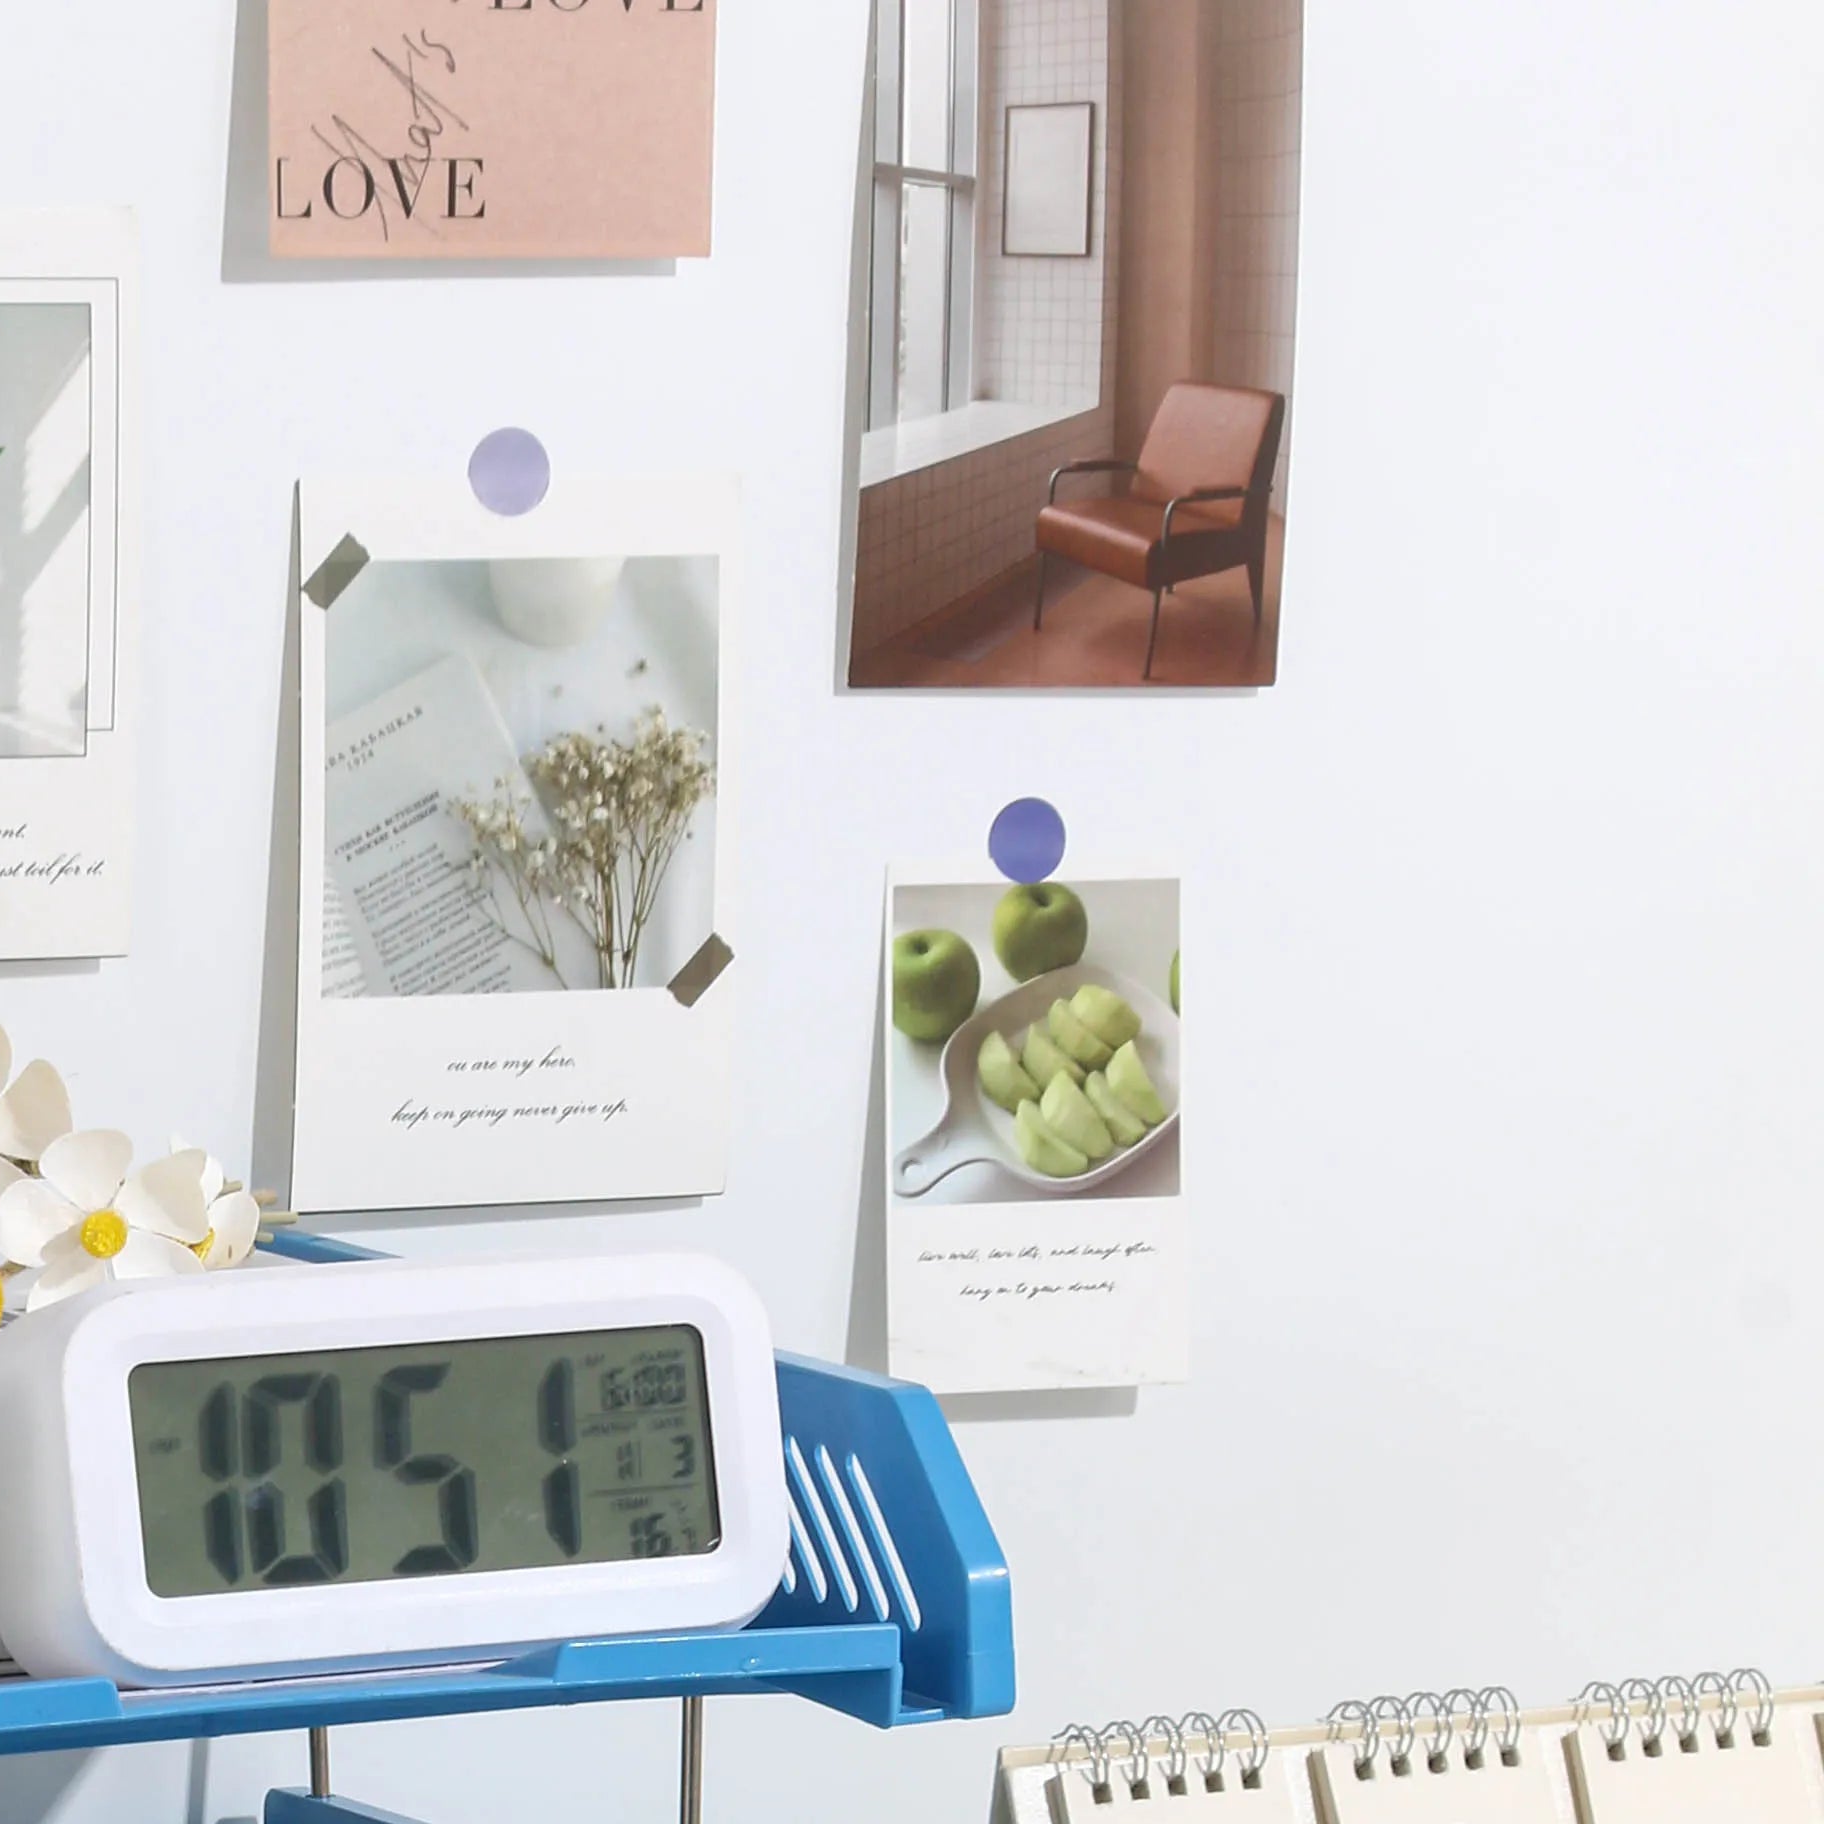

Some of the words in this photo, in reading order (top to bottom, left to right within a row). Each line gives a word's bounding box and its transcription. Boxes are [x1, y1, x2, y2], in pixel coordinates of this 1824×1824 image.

[277, 157, 485, 219] LOVE
[24, 857, 54, 878] toil
[50, 853, 81, 886] for
[471, 1059, 497, 1071] are
[503, 1057, 534, 1078] my
[391, 1099, 428, 1130] keep
[433, 1110, 454, 1121] on
[453, 1105, 508, 1128] going
[513, 1107, 557, 1118] never
[556, 1101, 597, 1124] give
